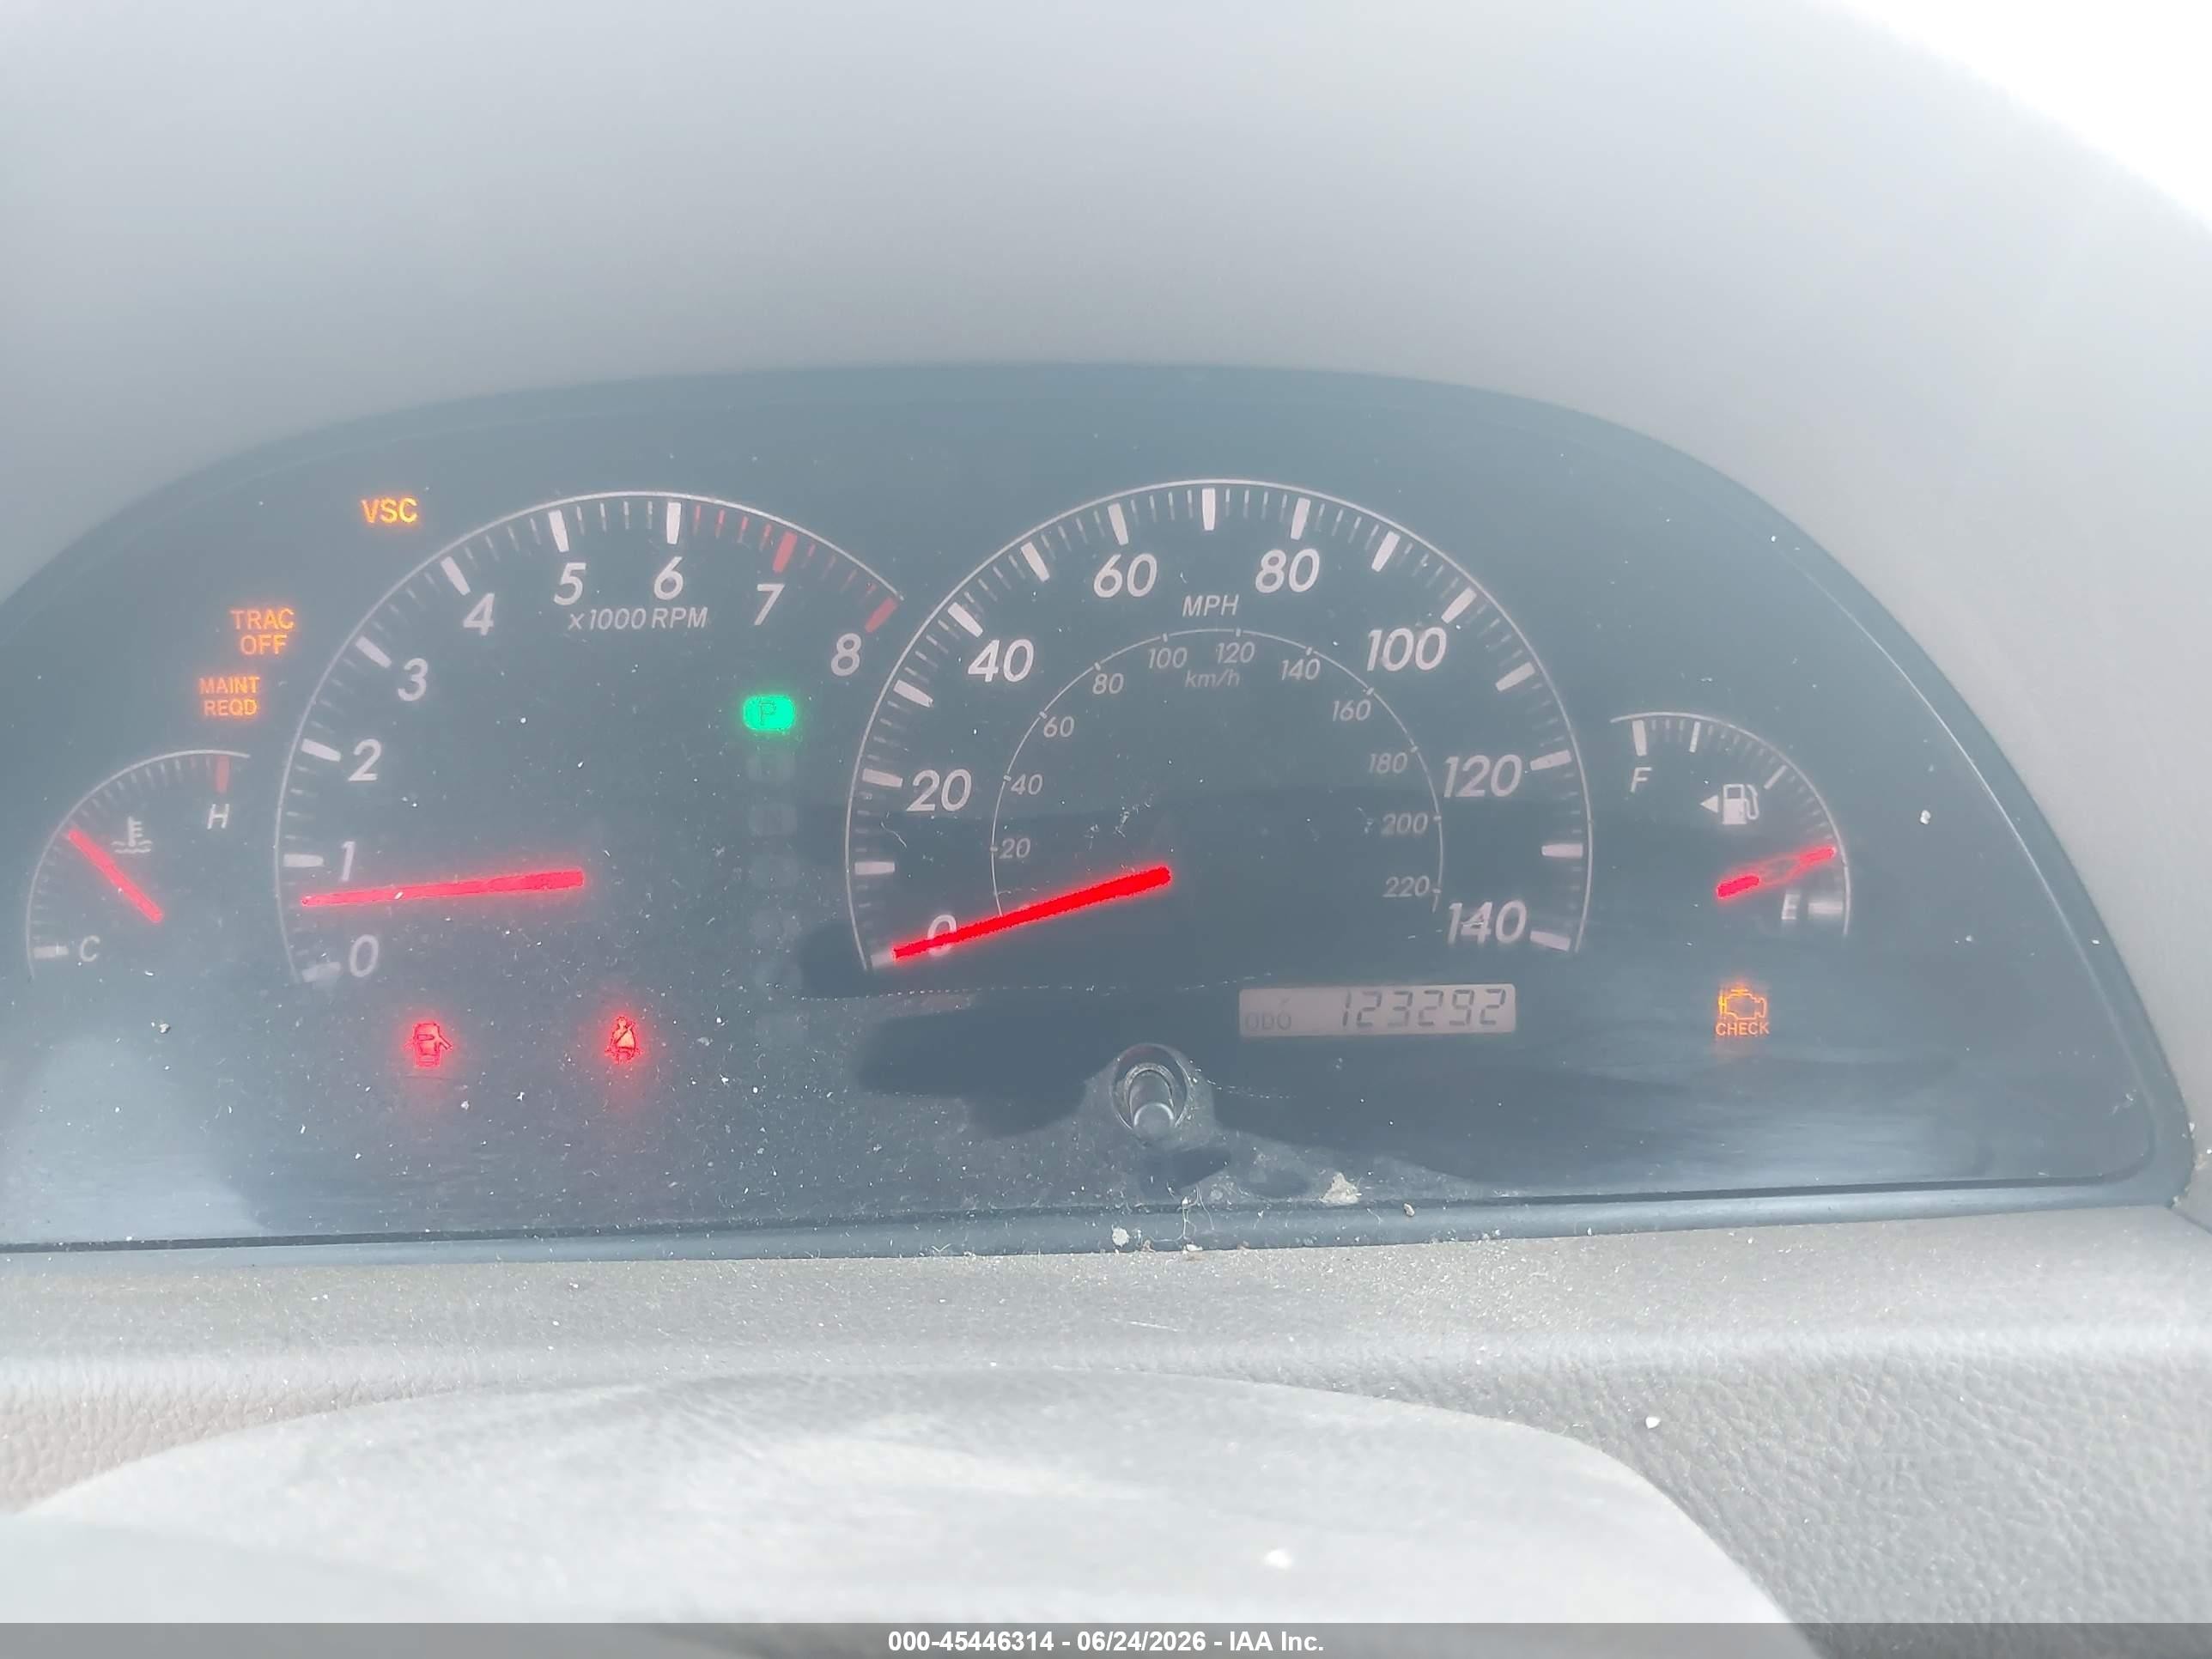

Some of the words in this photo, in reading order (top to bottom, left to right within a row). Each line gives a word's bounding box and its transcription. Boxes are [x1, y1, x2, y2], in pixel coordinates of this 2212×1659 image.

[362, 498, 418, 524] VSC
[554, 562, 586, 605] 5
[654, 556, 684, 599] 6
[1094, 554, 1158, 599] 60
[1255, 549, 1320, 592] 80
[463, 593, 495, 635] 4
[651, 606, 708, 629] RPM
[754, 584, 784, 625] 7
[1182, 595, 1239, 617] MPH
[230, 608, 295, 630] TRAC
[240, 634, 288, 654] OFF
[830, 633, 860, 677] 8
[1215, 641, 1256, 664] 120
[1367, 628, 1447, 672] 100
[968, 639, 1035, 683] 40
[1147, 647, 1188, 668] 100
[1280, 659, 1321, 681] 140
[199, 676, 260, 694] MAINT
[398, 658, 428, 702] 3
[1092, 672, 1124, 695] 80
[1184, 666, 1241, 688] km/h
[204, 698, 258, 716] REQD
[757, 702, 776, 726] P
[1331, 700, 1371, 721] 160
[1042, 715, 1075, 738] 60
[348, 738, 382, 781] 2
[1368, 752, 1408, 775] 180
[1011, 774, 1043, 796] 40
[1443, 754, 1522, 798] 120
[1630, 766, 1653, 793] F
[906, 769, 972, 811] 20
[208, 804, 229, 830] H
[1382, 813, 1429, 835] 200
[341, 841, 357, 882] 1
[1000, 838, 1030, 859] 20
[1382, 876, 1431, 898] 220
[1781, 893, 1801, 920] E
[927, 915, 957, 956] 0
[1447, 901, 1527, 945] 140
[79, 936, 100, 962] C
[349, 933, 380, 977] 0
[1244, 1012, 1291, 1030] ODO
[1341, 988, 1507, 1028] 123292
[1716, 1022, 1770, 1036] CHECK
